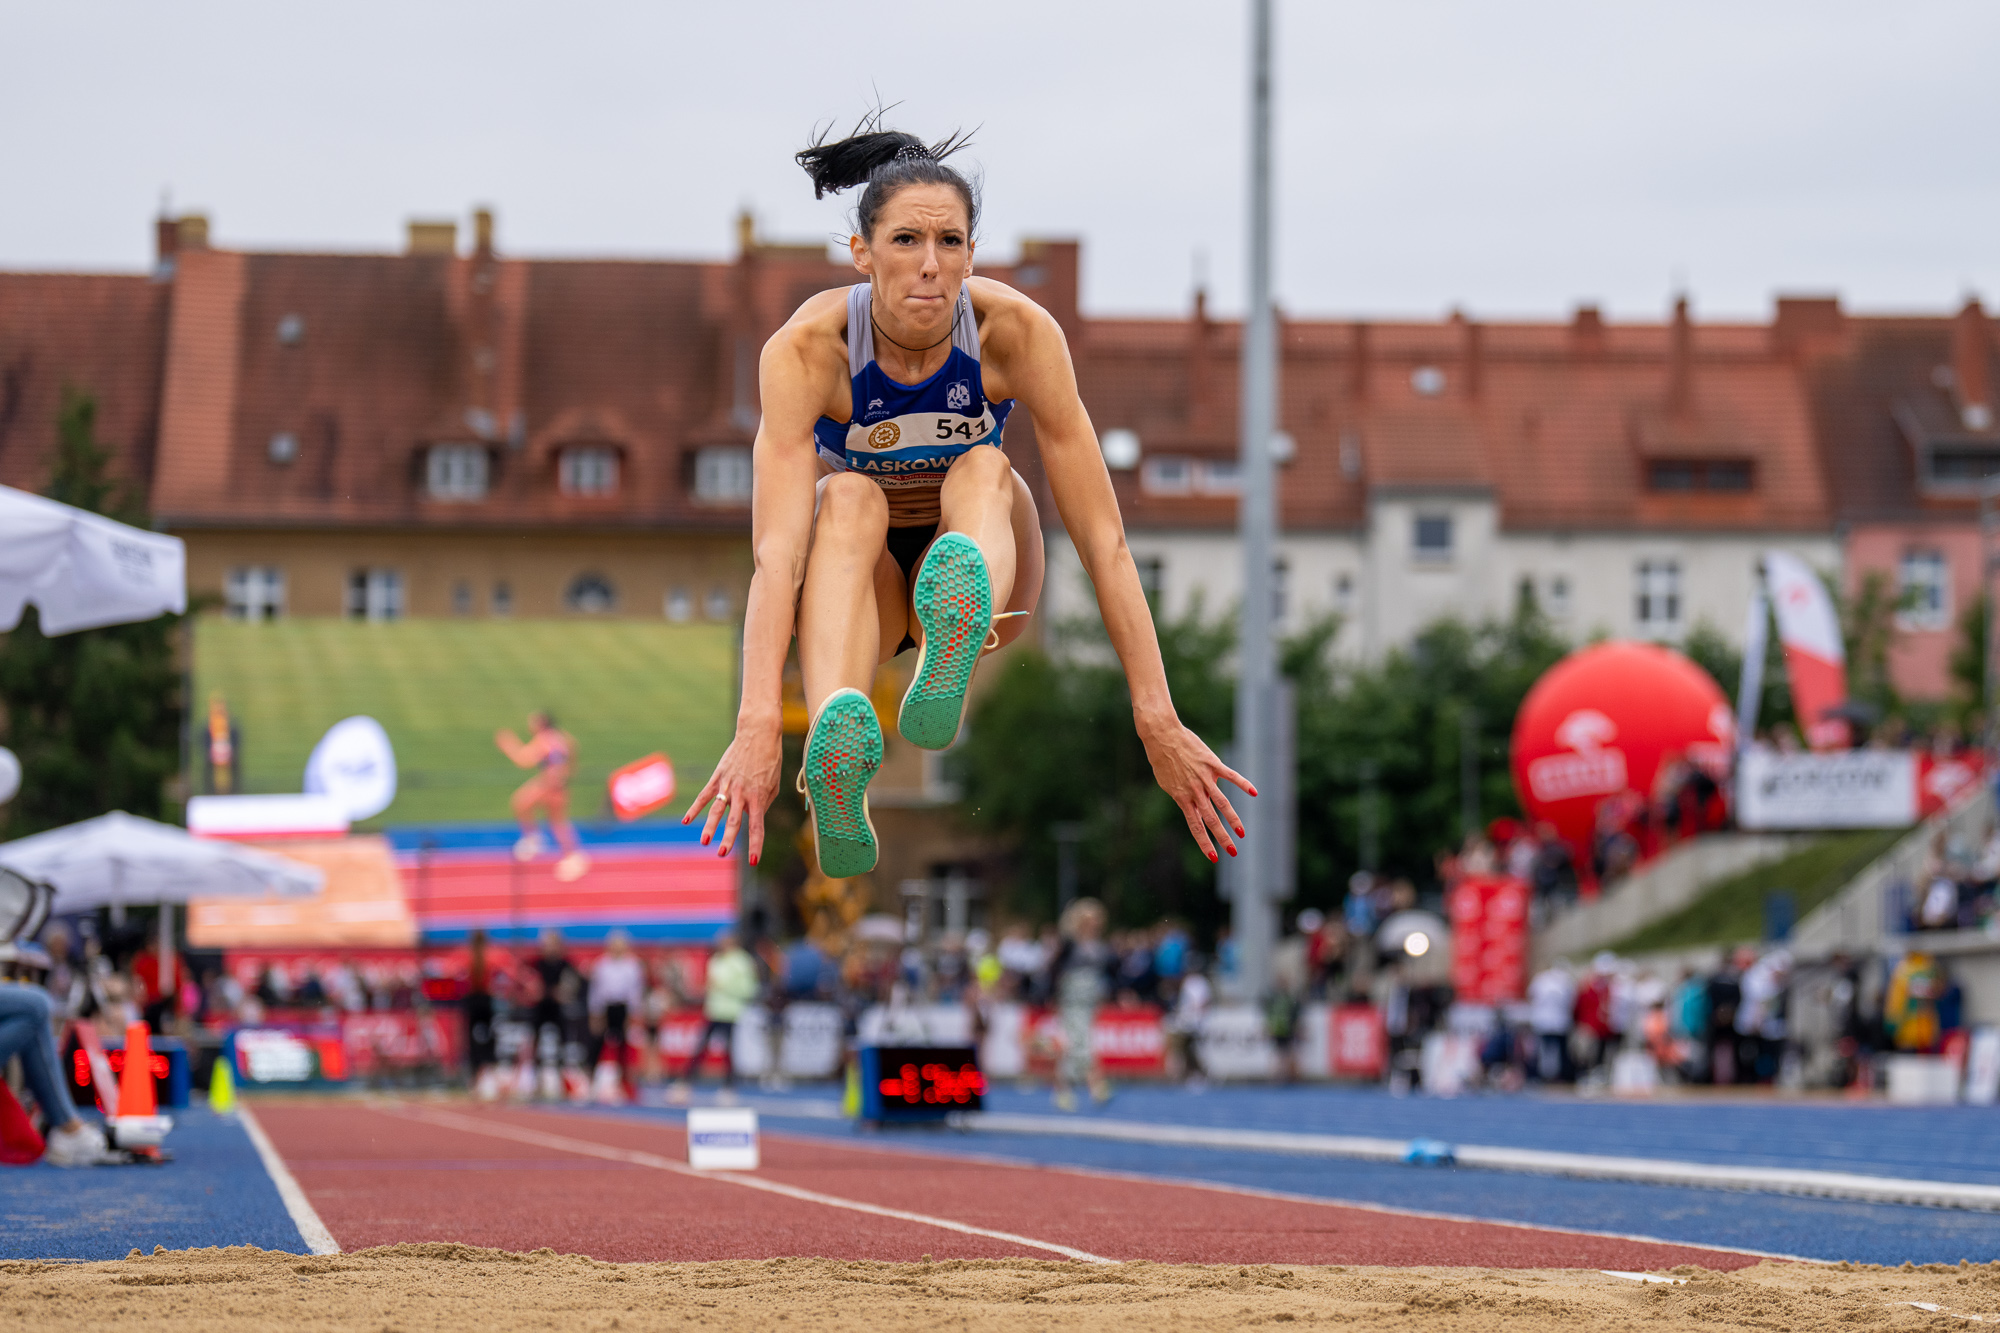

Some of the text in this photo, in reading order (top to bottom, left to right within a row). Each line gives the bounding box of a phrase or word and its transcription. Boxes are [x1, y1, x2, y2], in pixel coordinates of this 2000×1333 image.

[935, 418, 989, 440] 541
[852, 456, 956, 473] LASKOW
[871, 476, 897, 486] ZÓW
[904, 472, 945, 481] Mistrzost
